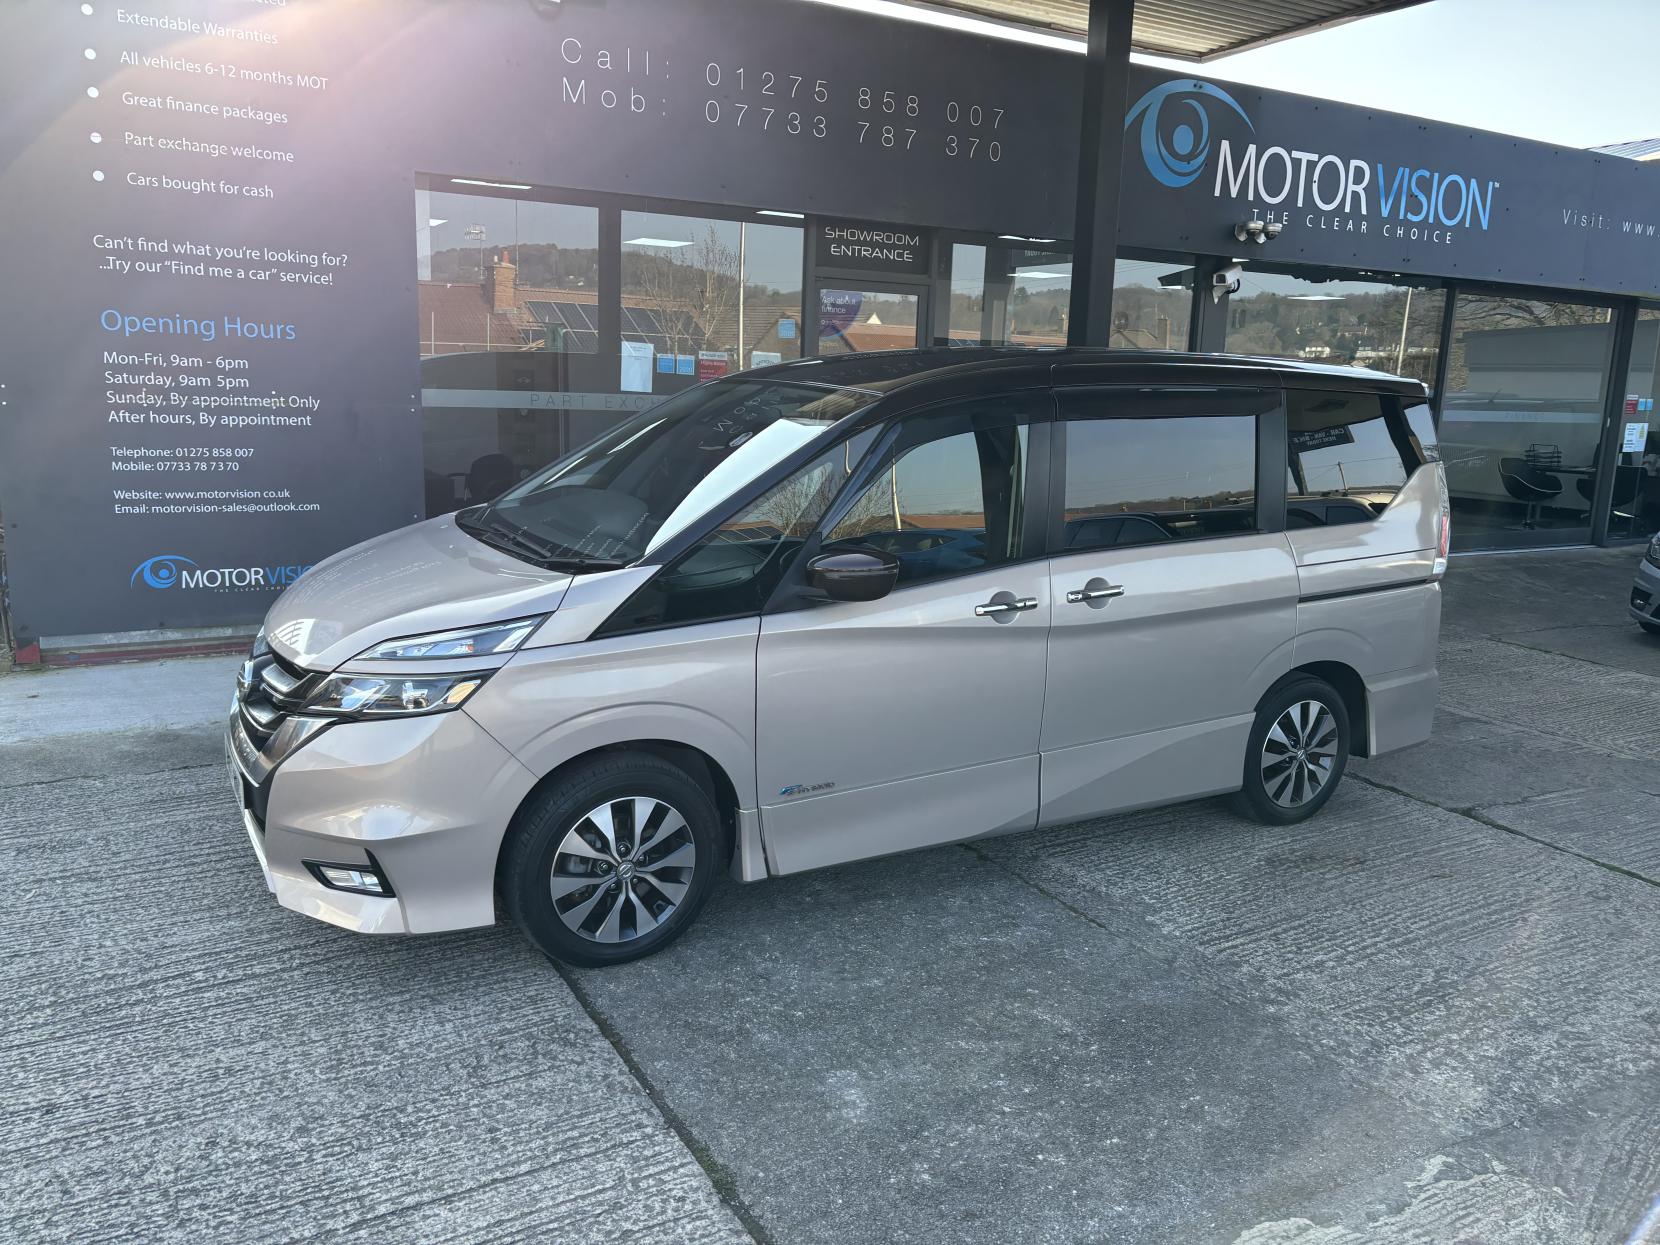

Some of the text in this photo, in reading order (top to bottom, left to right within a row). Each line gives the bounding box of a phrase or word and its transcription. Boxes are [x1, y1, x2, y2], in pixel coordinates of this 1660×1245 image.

[117, 9, 279, 45] Extendable Warranties
[120, 50, 328, 90] All vehicles 6-12 months MOT
[561, 37, 1005, 128] Call: 01275 858 007
[122, 91, 289, 126] Great finance packages
[561, 77, 1002, 162] Mob: 07733 787 370
[125, 131, 295, 163] Part exchange welcome
[126, 172, 274, 199] Cars bought for cash
[1252, 208, 1452, 244] THE CLEAR CHOICE
[1562, 208, 1610, 230] Visit:
[824, 226, 919, 246] SHOWROOM
[93, 234, 348, 268] Can't find what you're looking for?
[830, 244, 913, 262] ENTRANCE
[135, 261, 162, 273] our
[208, 266, 233, 279] me
[236, 269, 245, 279] a
[280, 271, 333, 286] service!
[100, 309, 297, 342] Opening Hours
[103, 351, 168, 368] Mon-Fri,
[170, 354, 203, 368] 9am
[215, 356, 249, 371] 6pm
[104, 371, 249, 390] Saturday, 9am 5pm
[106, 390, 320, 410] Sunday, By appointment Only
[108, 410, 312, 427] After hours, By appointment
[110, 446, 254, 459] Telephone: 01275 858 007
[111, 461, 154, 471] Mobile:
[156, 461, 191, 471] 07733
[194, 461, 208, 471] 78
[113, 489, 162, 500] Website:
[114, 502, 320, 514] Email: motorvision-sales@outlook.com
